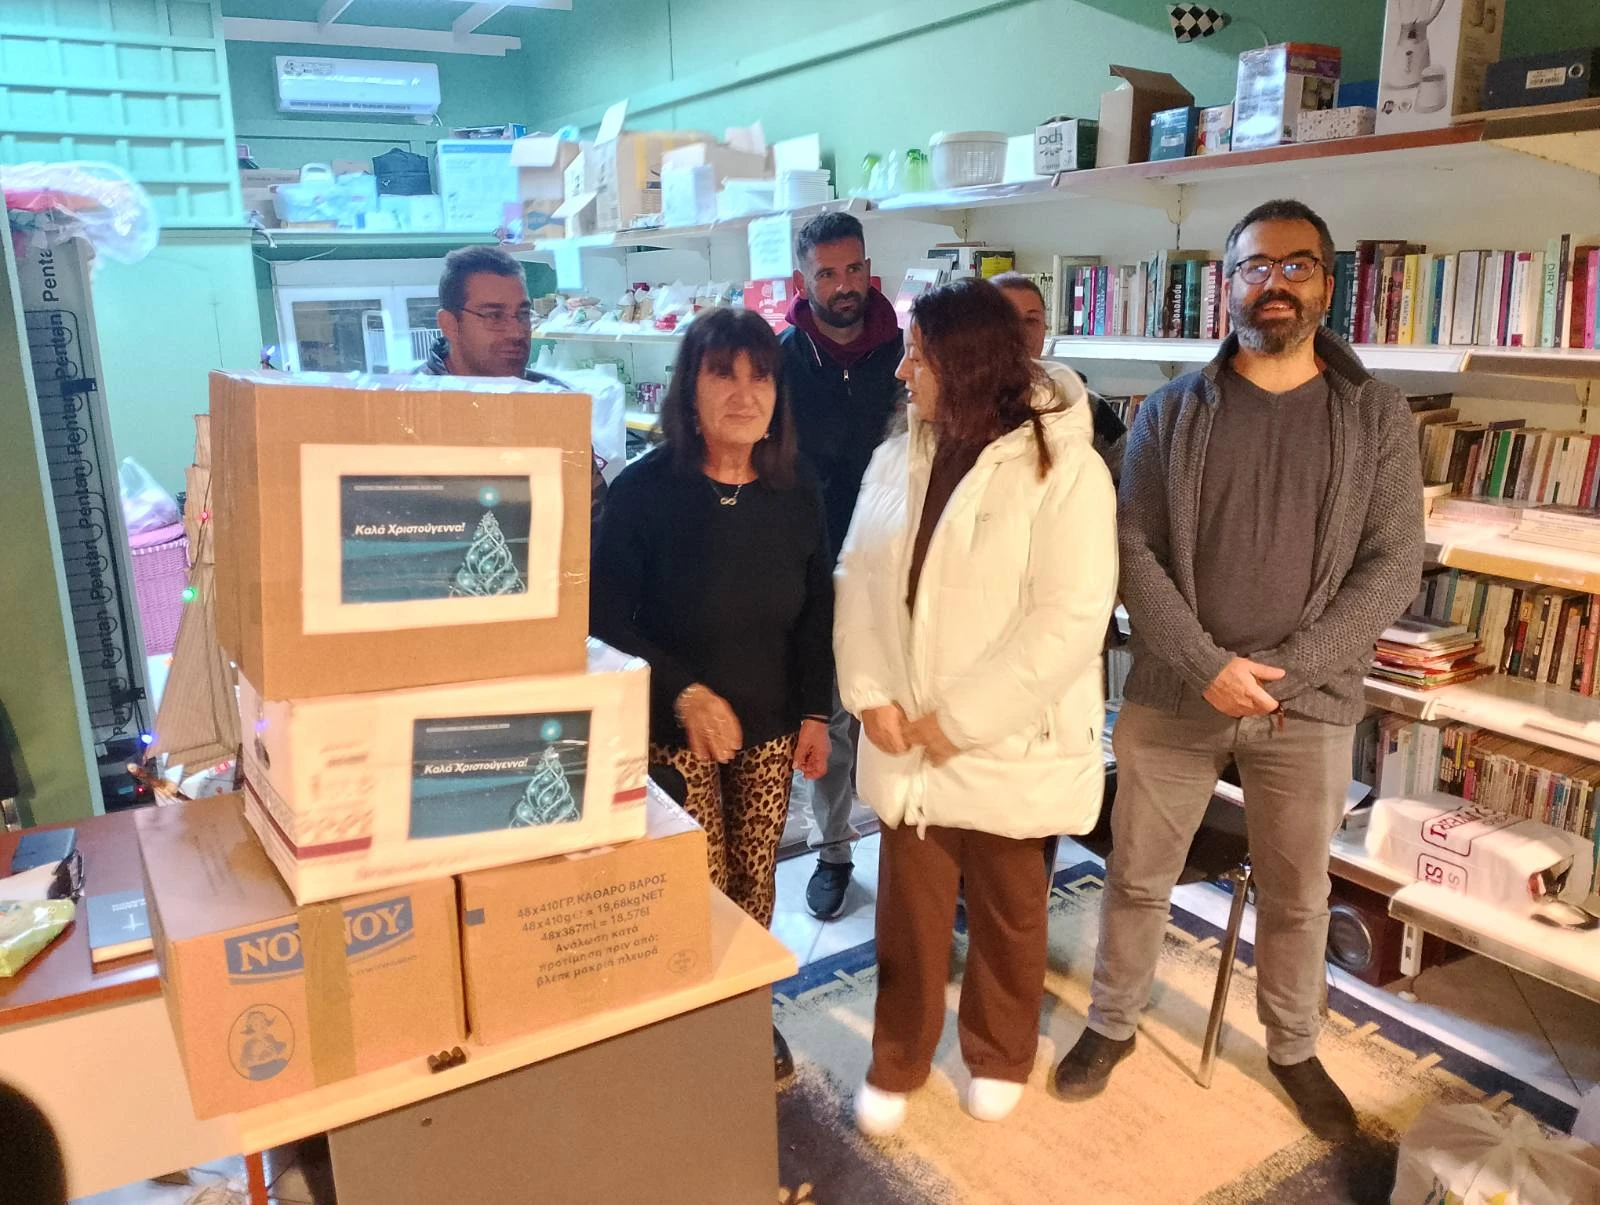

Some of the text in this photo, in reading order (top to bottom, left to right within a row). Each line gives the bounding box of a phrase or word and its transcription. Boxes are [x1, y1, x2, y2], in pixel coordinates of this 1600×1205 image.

[51, 313, 69, 379] Pentan
[355, 522, 466, 536] Καλά Χριστούγεννα!
[424, 758, 529, 774] Καλά Χριστούγεννα!
[629, 873, 668, 891] ΒΑΡΟΣ
[641, 888, 665, 902] NET
[555, 925, 639, 953] Ανάλωση κατά
